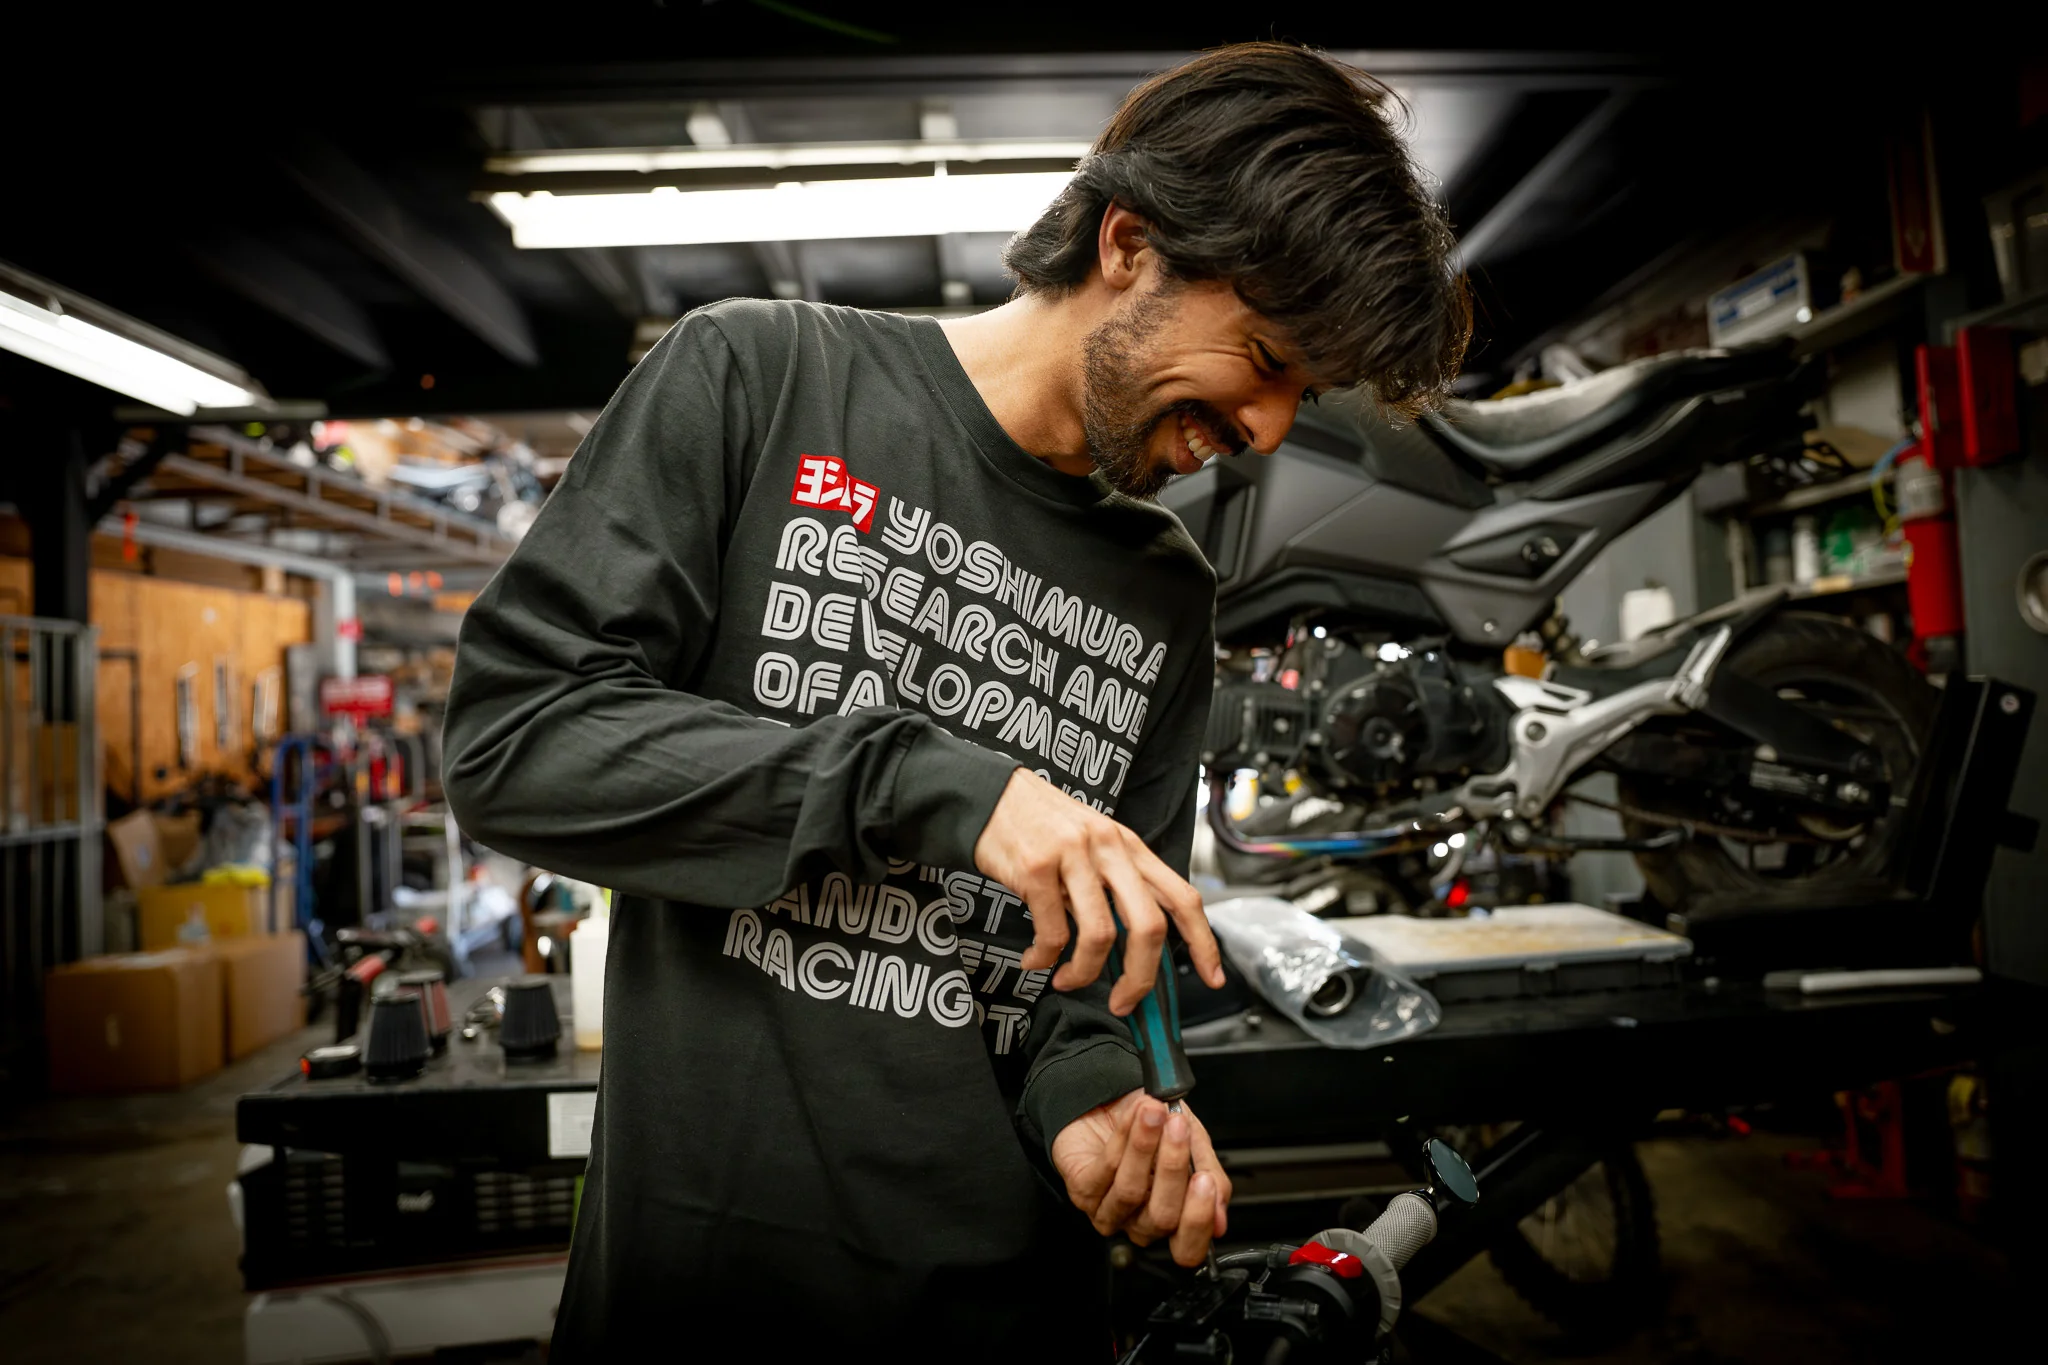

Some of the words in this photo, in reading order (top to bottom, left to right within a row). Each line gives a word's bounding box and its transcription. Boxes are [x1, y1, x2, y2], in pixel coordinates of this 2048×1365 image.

[775, 517, 1059, 696] RESEARCH
[1059, 665, 1149, 744] AND
[881, 496, 1168, 688] YOSHIMURA
[722, 909, 974, 1028] RACING
